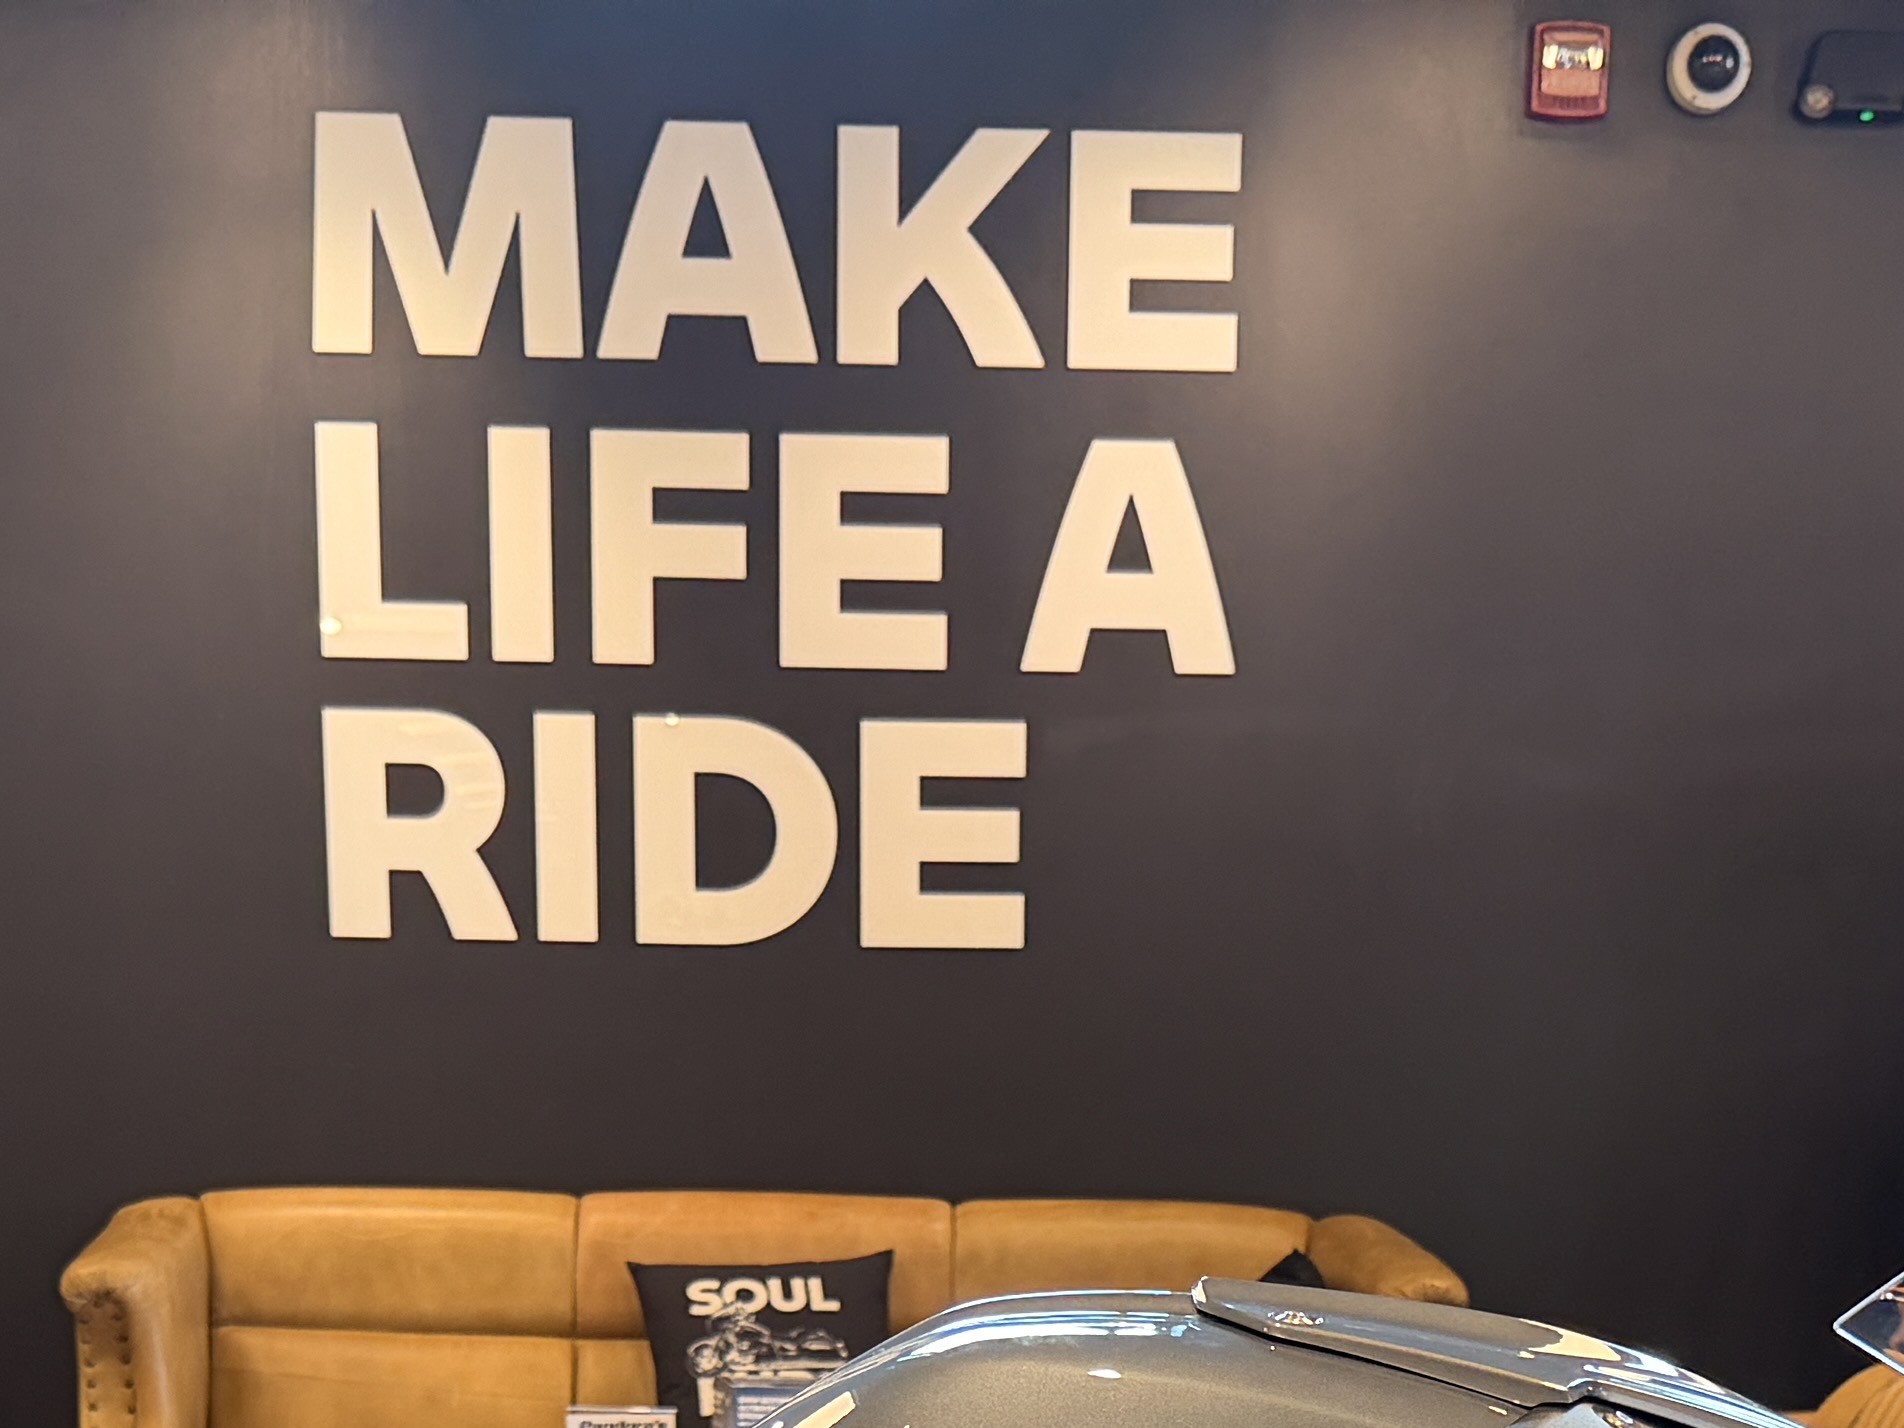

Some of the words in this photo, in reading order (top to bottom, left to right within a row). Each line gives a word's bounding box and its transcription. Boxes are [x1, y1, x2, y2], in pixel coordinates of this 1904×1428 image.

[312, 110, 1243, 372] MAKE
[315, 420, 950, 672] LIFE
[1020, 438, 1236, 676] A
[321, 706, 1028, 949] RIDE
[686, 1275, 841, 1316] SOUL
